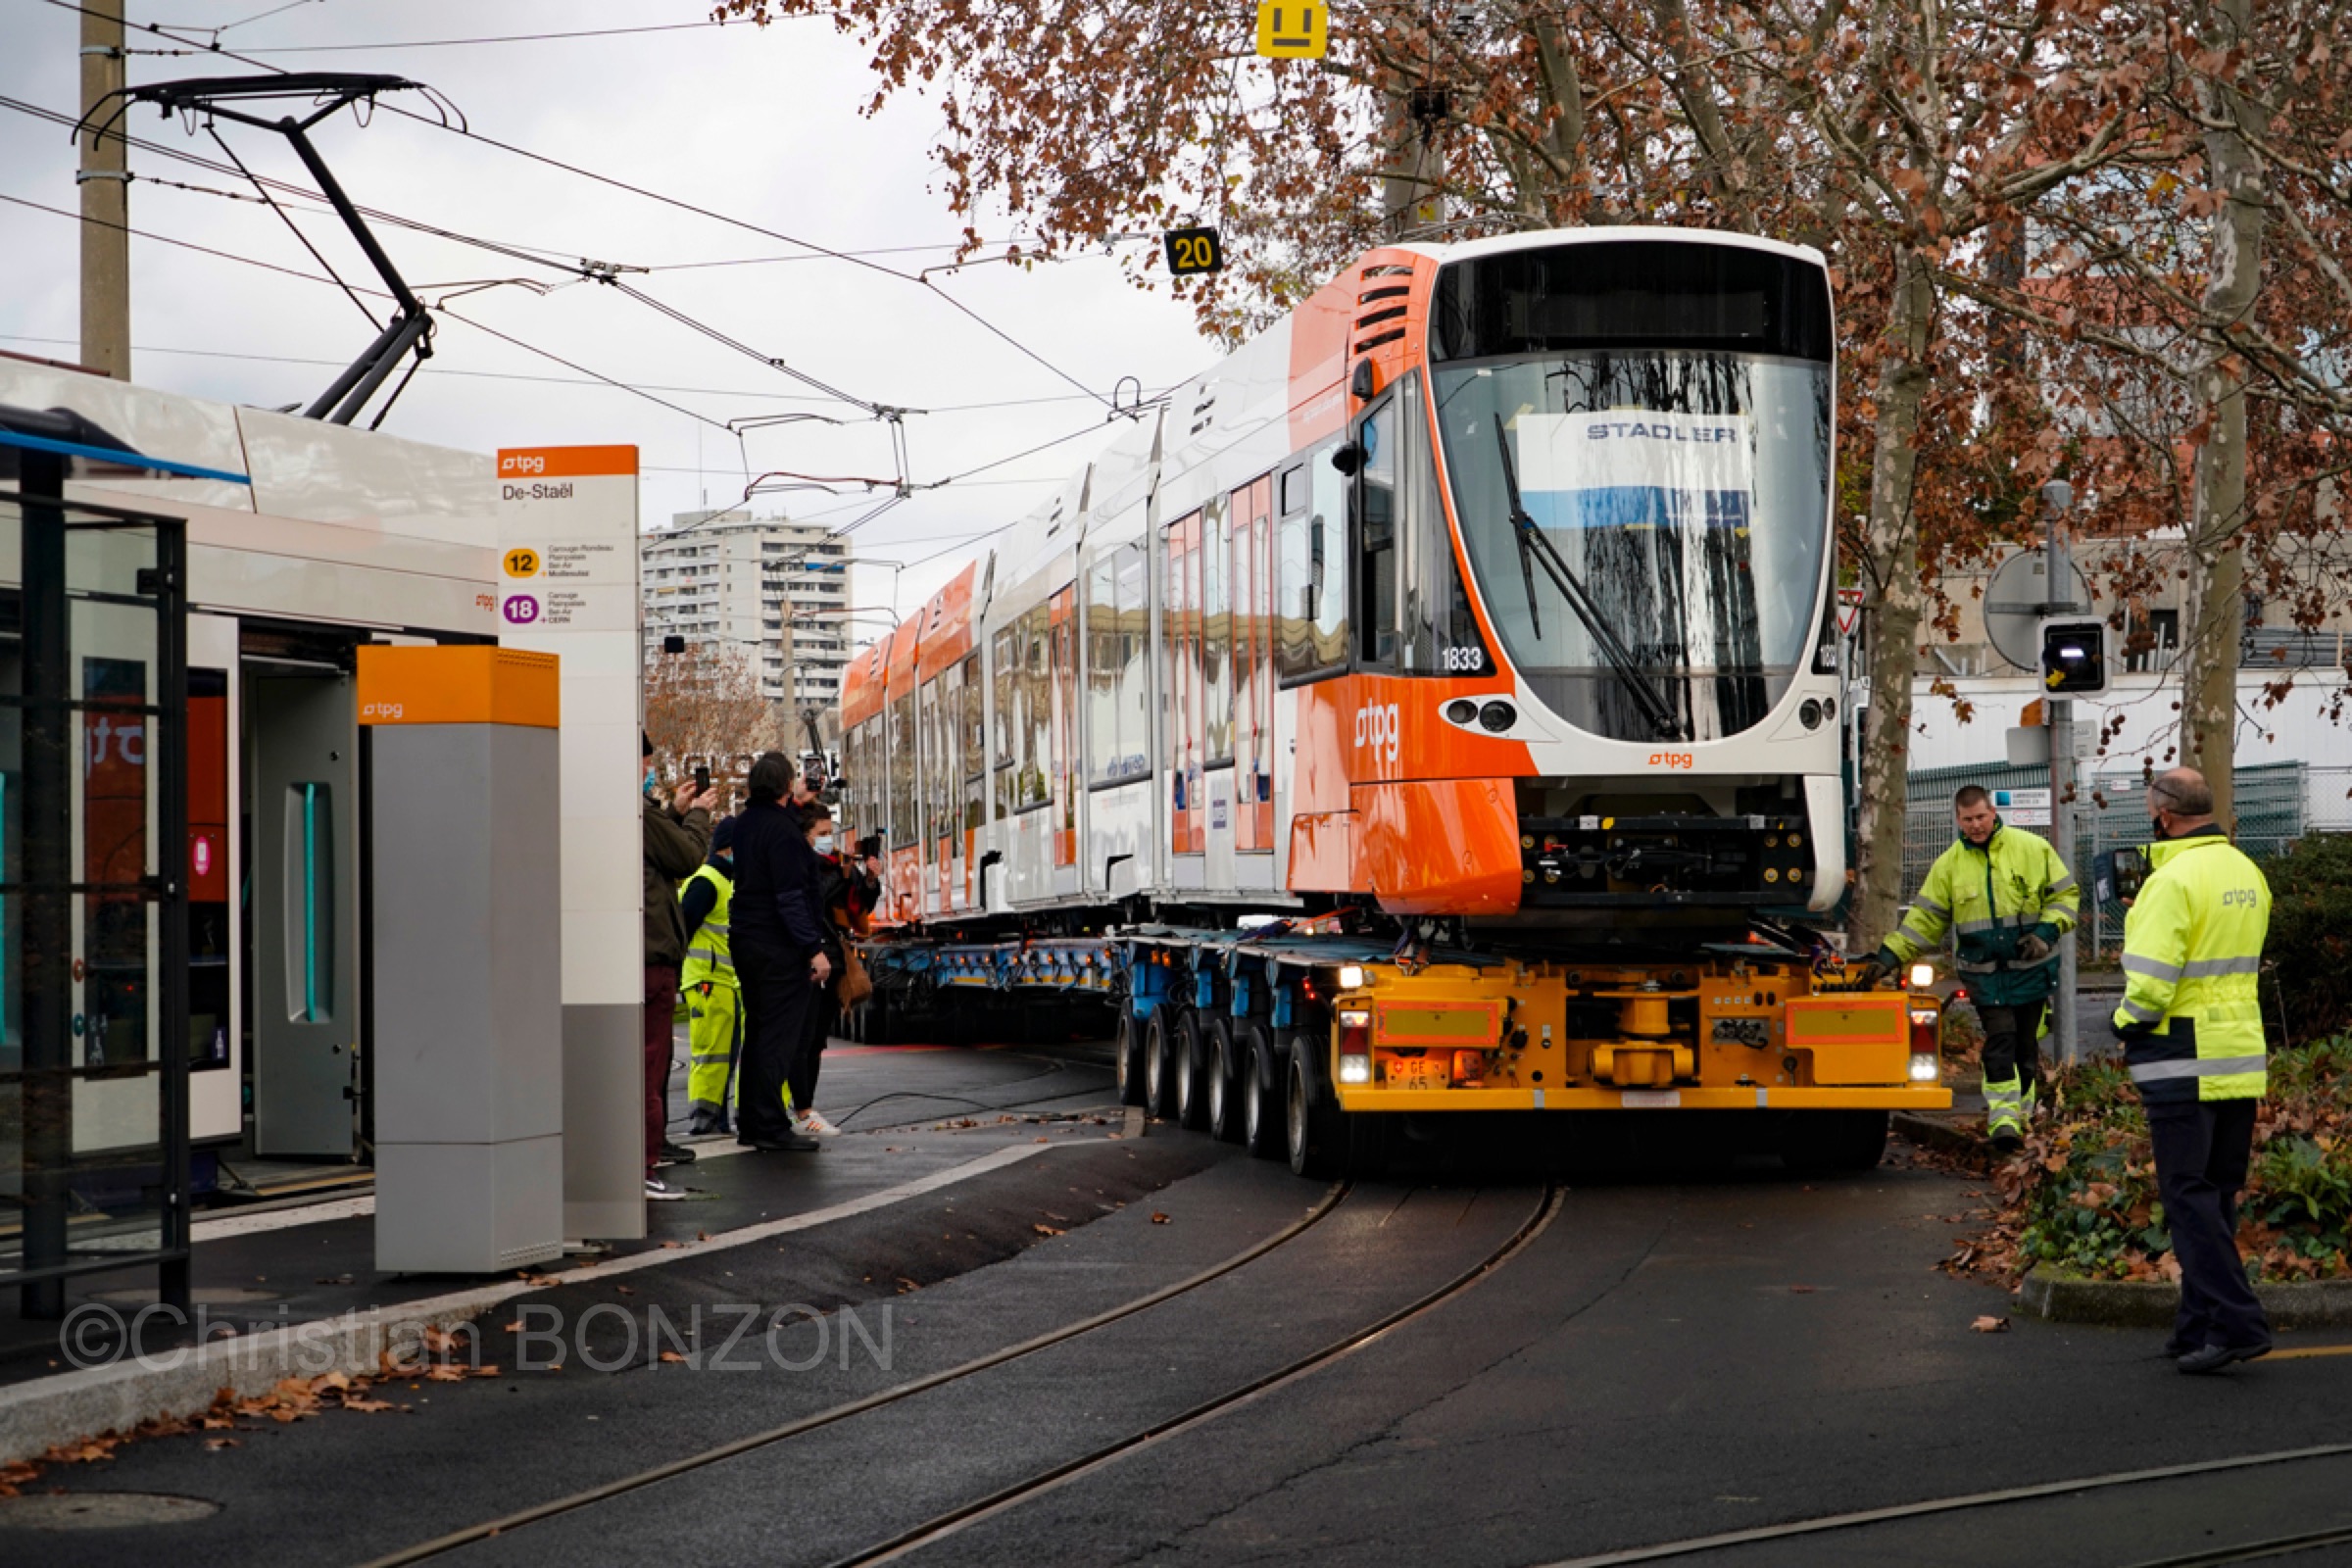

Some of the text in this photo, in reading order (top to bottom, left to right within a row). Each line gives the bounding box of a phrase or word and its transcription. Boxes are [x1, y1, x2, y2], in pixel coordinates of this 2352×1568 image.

[1175, 236, 1212, 269] 20
[1587, 422, 1738, 444] STADLER
[516, 454, 545, 473] tpg
[502, 482, 573, 501] De-Staël
[510, 555, 533, 571] 12
[509, 601, 533, 618] 18
[1442, 647, 1482, 670] 1833
[377, 702, 404, 718] tpg
[1368, 698, 1398, 761] tpg
[1664, 752, 1692, 769] tpg
[2233, 888, 2257, 908] tpg
[1410, 1060, 1426, 1074] GE
